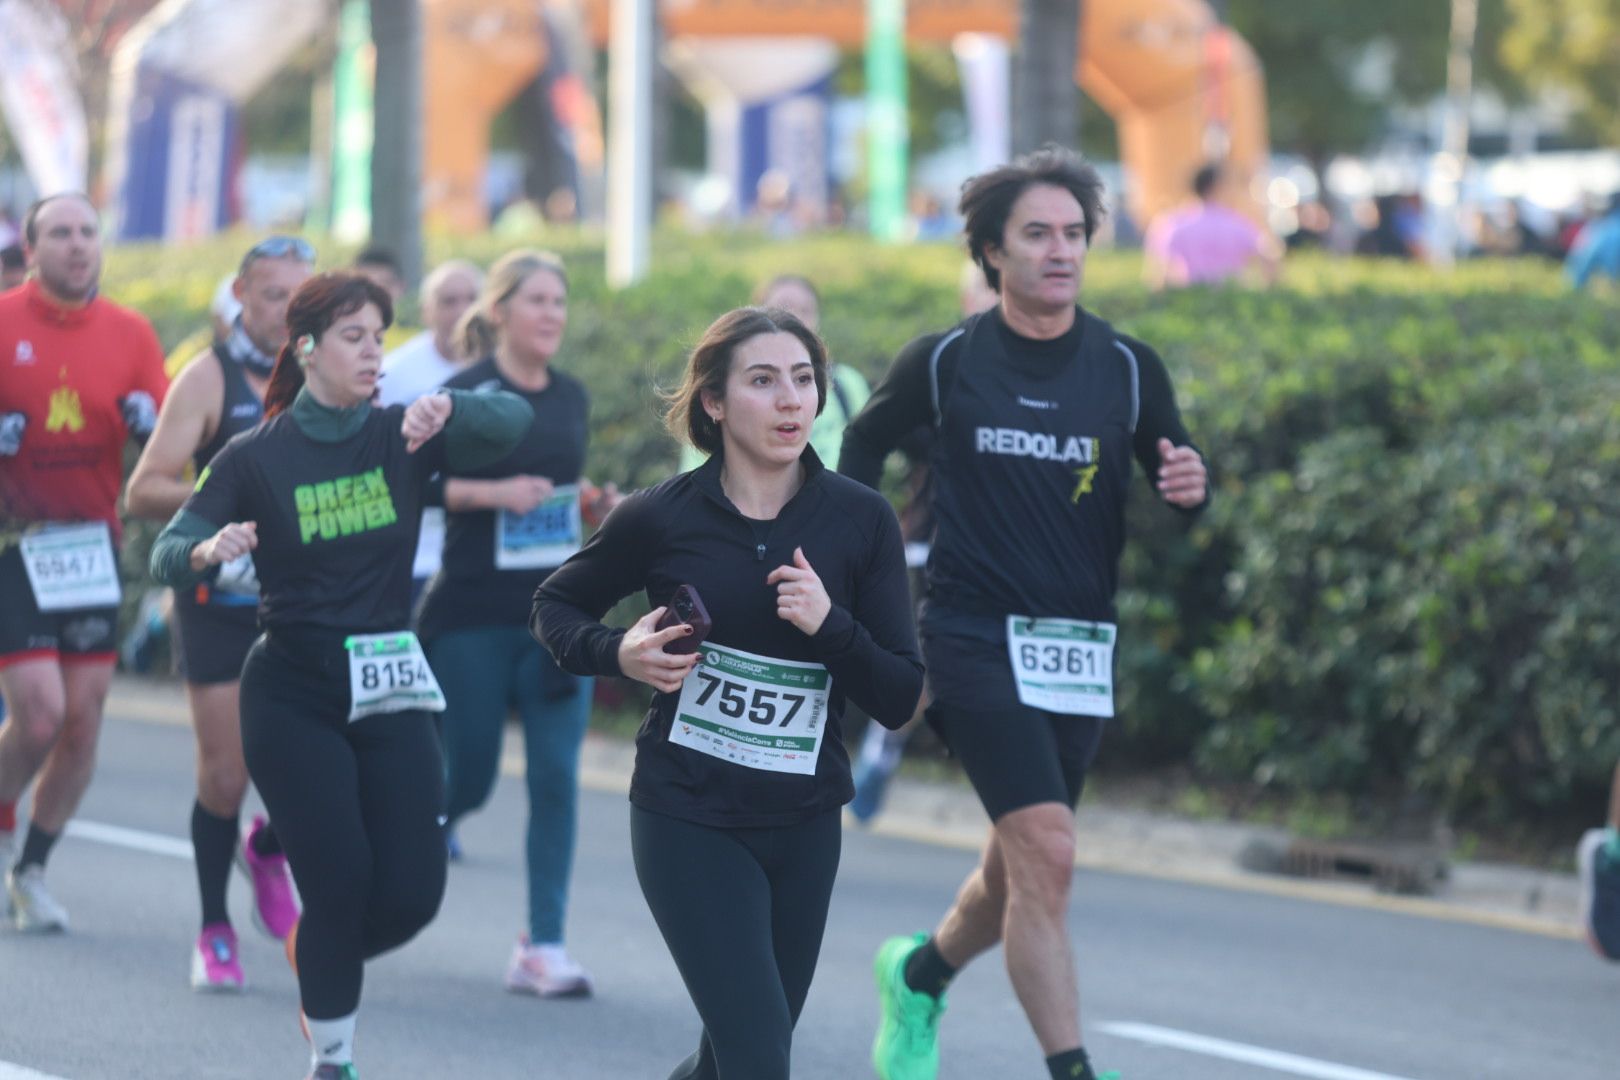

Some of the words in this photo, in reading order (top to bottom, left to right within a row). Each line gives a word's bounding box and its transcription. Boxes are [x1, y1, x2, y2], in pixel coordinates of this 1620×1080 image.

[975, 426, 1093, 463] REDOLAT
[294, 465, 390, 514] GREEN
[299, 496, 398, 544] POWER
[362, 660, 428, 690] 8154
[1020, 643, 1095, 676] 6361
[695, 671, 806, 728] 7557
